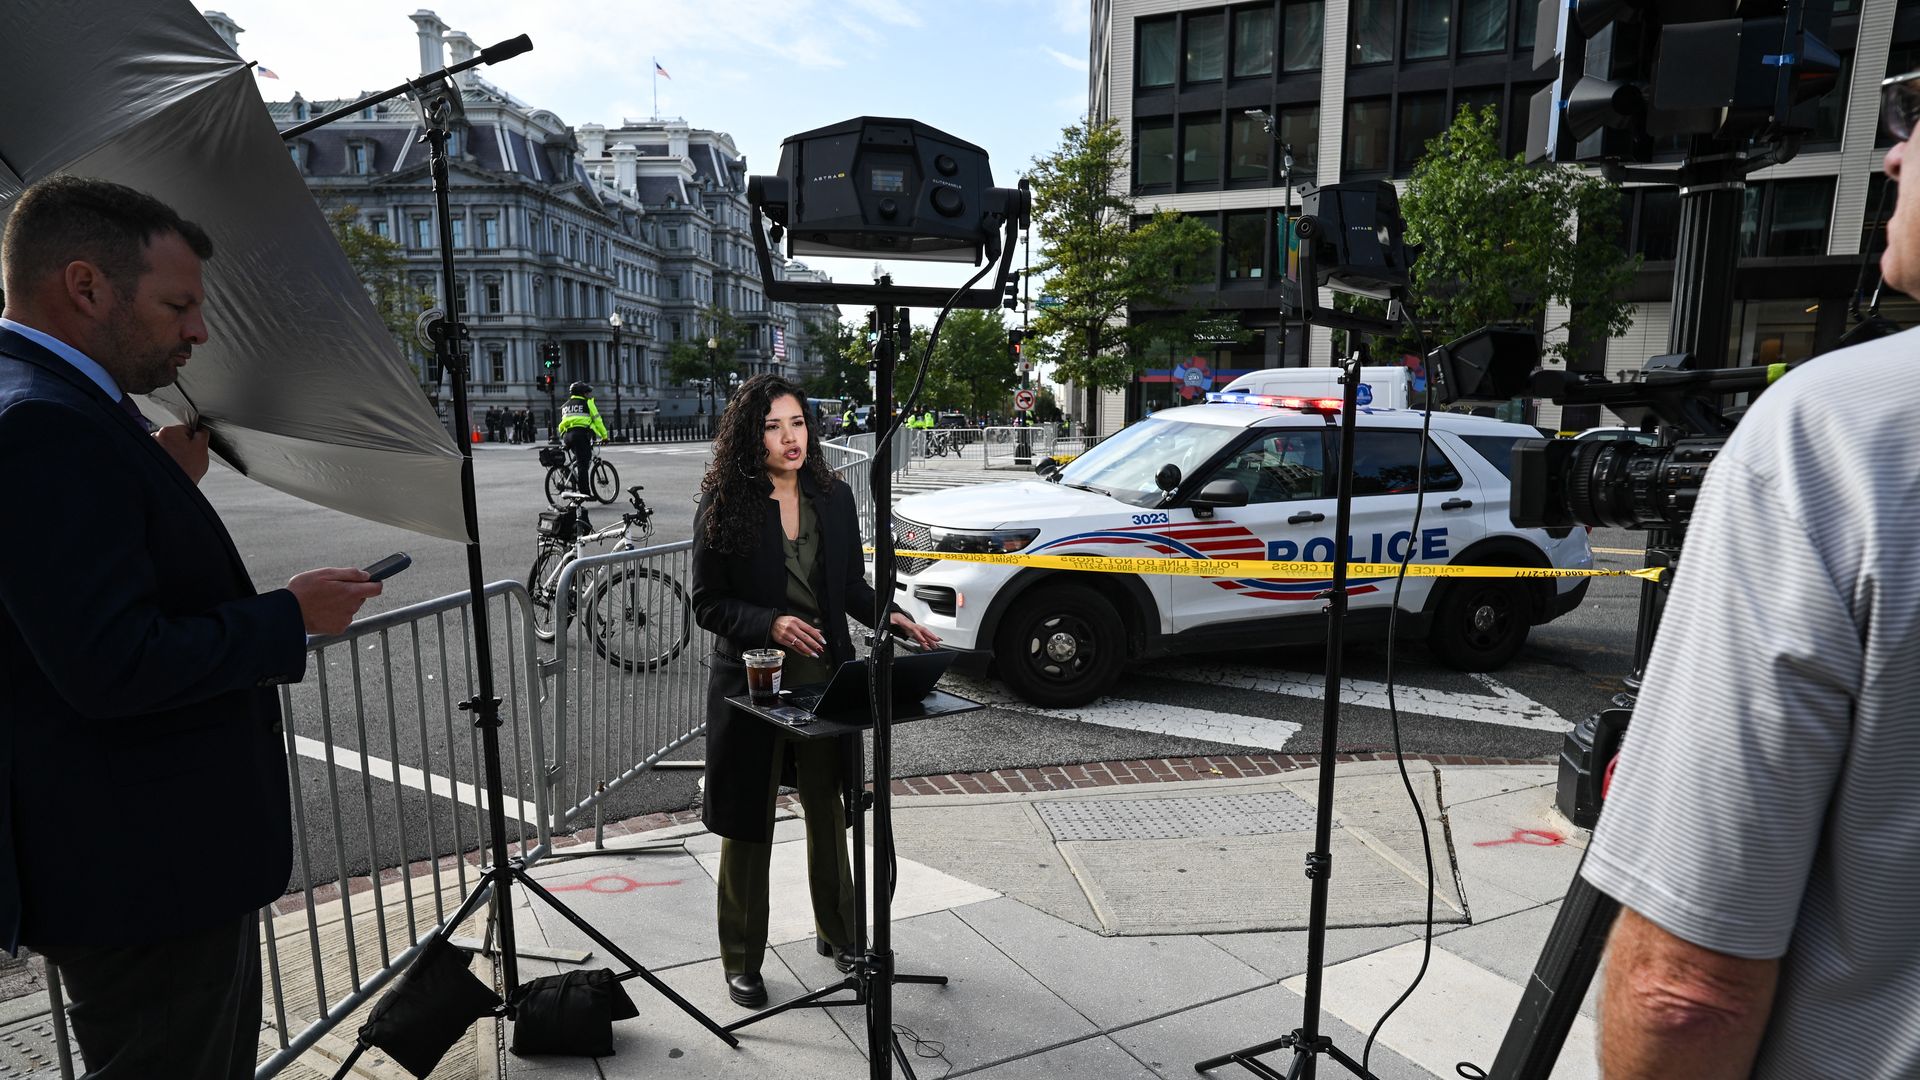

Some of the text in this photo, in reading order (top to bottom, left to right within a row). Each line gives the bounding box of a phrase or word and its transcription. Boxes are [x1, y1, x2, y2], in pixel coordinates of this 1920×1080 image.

[813, 174, 838, 182] ASTRA
[562, 405, 583, 415] POLICE
[1132, 513, 1169, 525] 3023
[1267, 528, 1449, 563] POLICE
